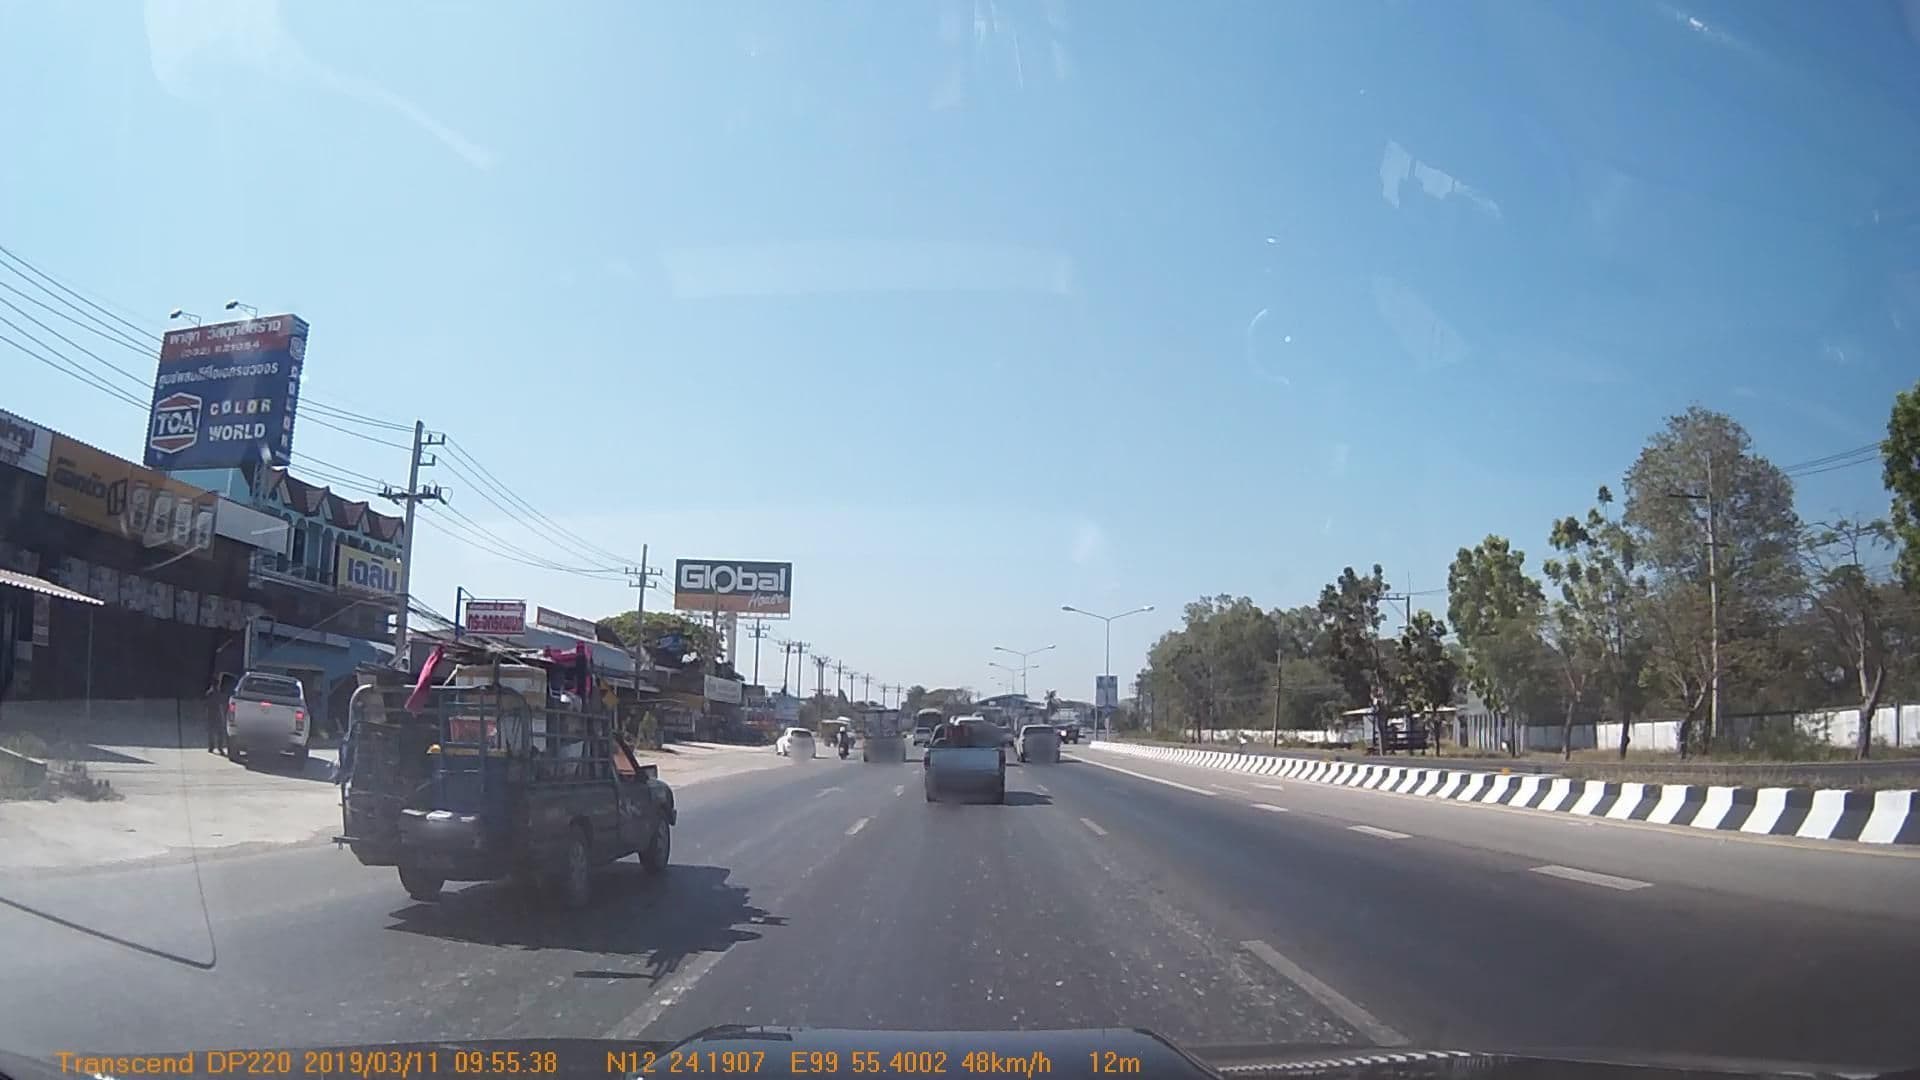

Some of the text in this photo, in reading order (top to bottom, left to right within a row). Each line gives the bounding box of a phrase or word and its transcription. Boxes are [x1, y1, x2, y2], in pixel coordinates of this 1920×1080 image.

[209, 399, 272, 416] COLOR
[158, 411, 195, 435] TOA
[209, 423, 266, 441] WORLD
